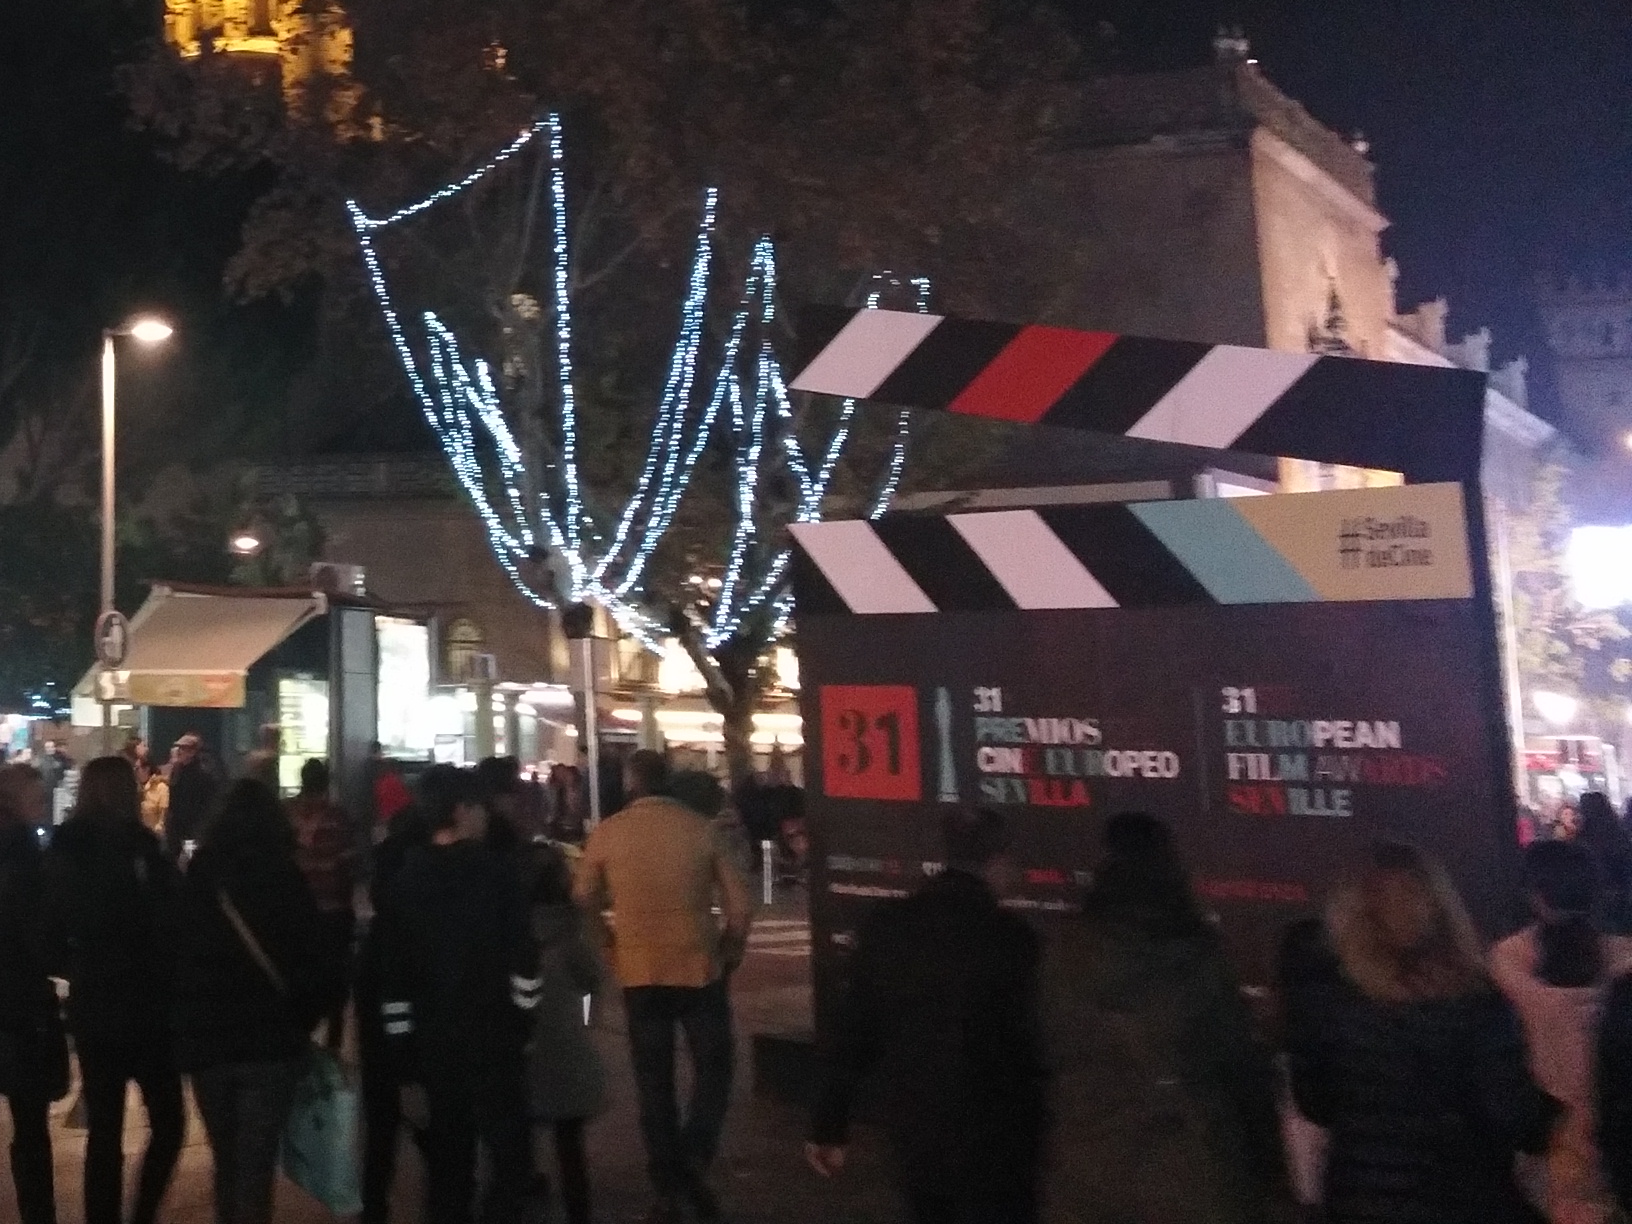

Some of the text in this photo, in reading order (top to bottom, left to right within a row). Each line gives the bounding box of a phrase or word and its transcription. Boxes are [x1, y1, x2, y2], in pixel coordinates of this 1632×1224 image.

[972, 686, 1003, 713] 31
[1221, 686, 1257, 714] 31
[835, 707, 902, 777] 31
[974, 717, 1103, 745] PREMIOS
[1224, 719, 1402, 749] EUROPEAN
[1045, 748, 1180, 778] EUROPEO
[1227, 752, 1309, 782] FILM
[979, 777, 1091, 807] SEVILLA
[1227, 783, 1354, 817] SEVILLE
